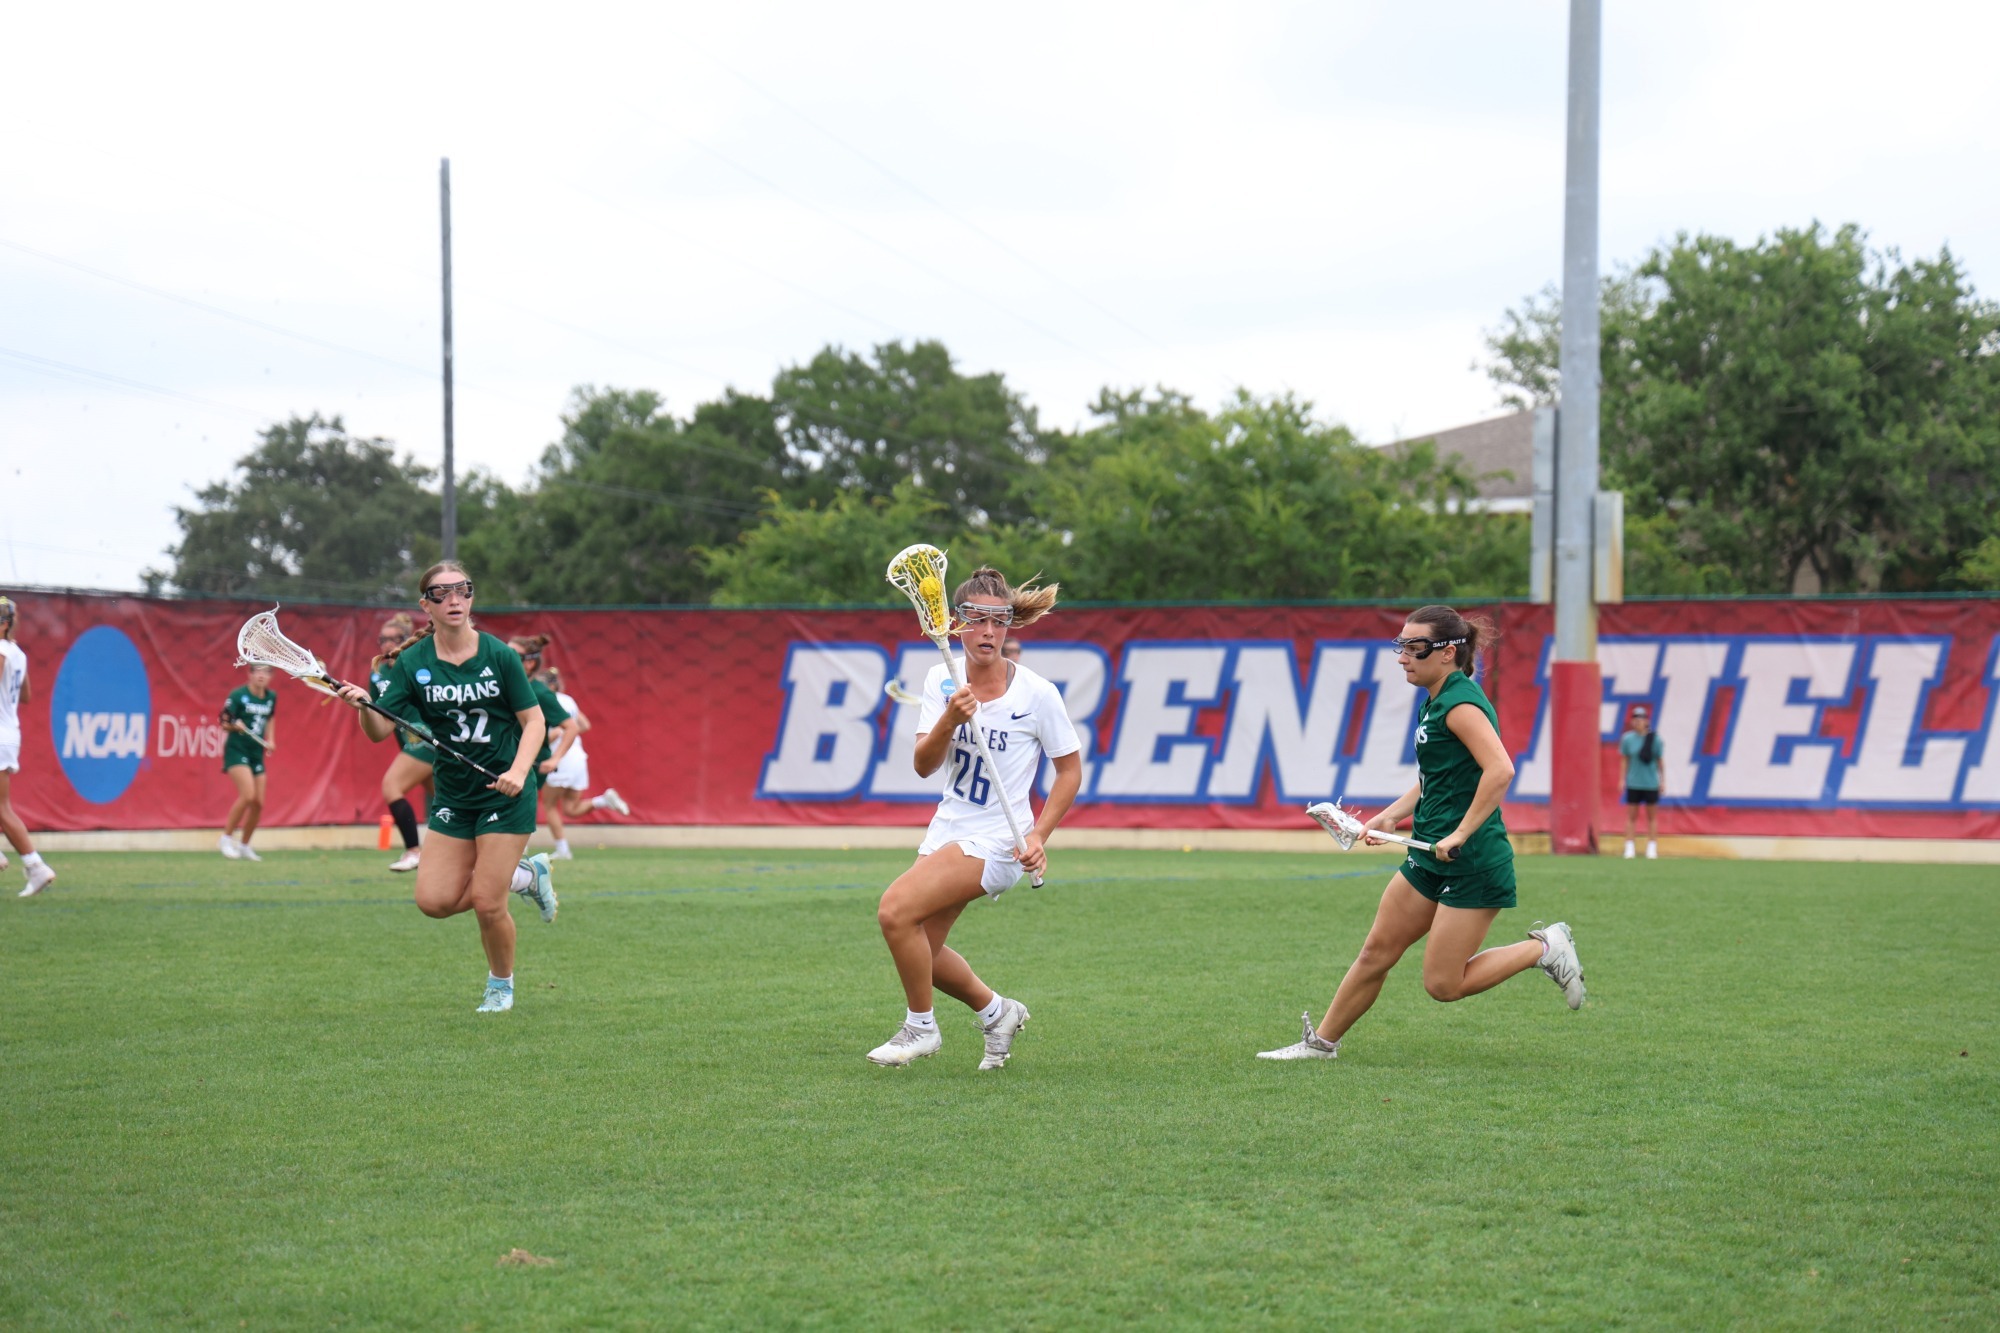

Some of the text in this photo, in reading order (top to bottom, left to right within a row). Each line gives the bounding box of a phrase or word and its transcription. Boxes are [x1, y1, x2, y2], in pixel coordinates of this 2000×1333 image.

[423, 680, 500, 707] TROJANS
[62, 711, 147, 759] NCAA
[157, 714, 229, 758] Divisi
[446, 708, 491, 743] 32
[1506, 635, 2000, 808] FIEL
[953, 748, 991, 806] 26
